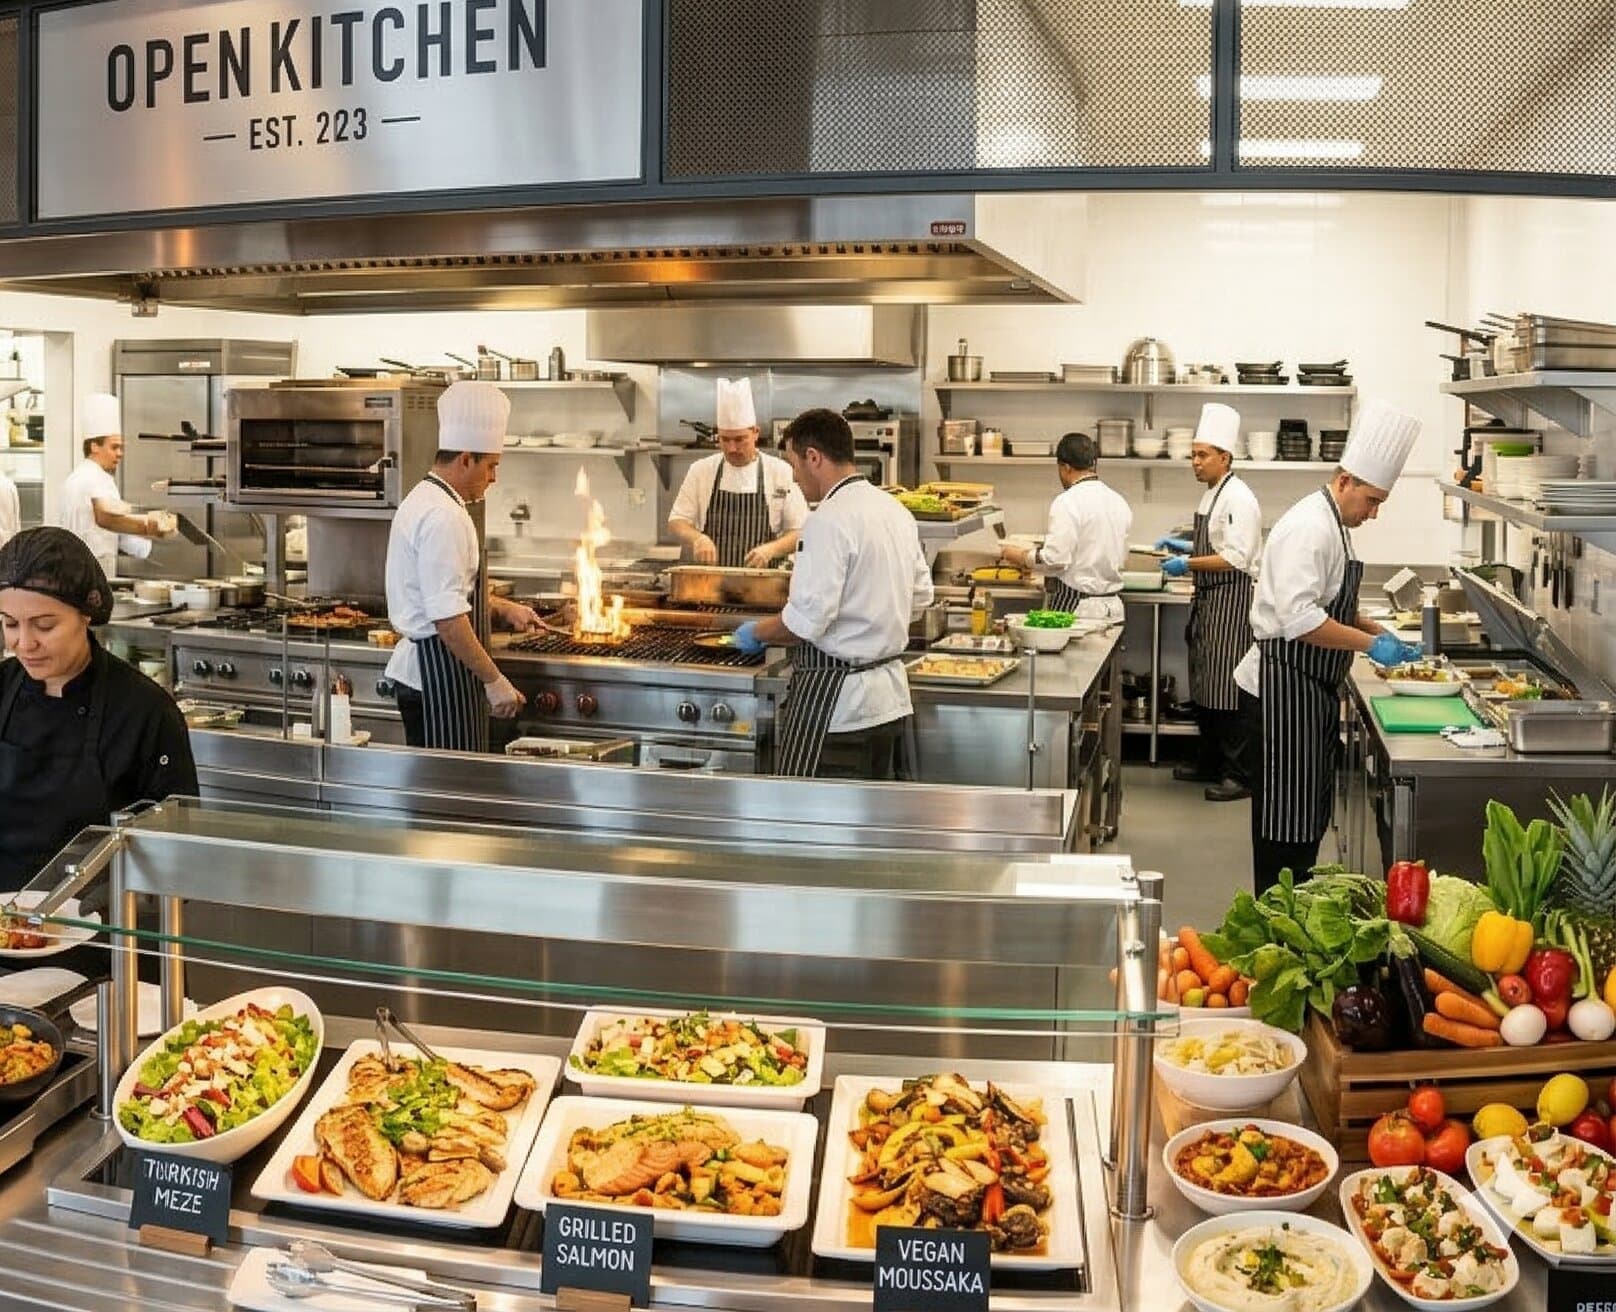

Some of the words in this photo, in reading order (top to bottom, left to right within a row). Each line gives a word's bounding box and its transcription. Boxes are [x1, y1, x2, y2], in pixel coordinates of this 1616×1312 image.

[107, 26, 251, 112] OPEN
[270, 0, 548, 93] KITCHEN
[249, 115, 303, 151] EST.
[154, 1186, 203, 1214] MEZE
[559, 1216, 636, 1244] GRILLED
[556, 1243, 635, 1272] SALMON
[898, 1239, 965, 1264] VEGAN
[879, 1266, 984, 1294] MOUSSAKA
